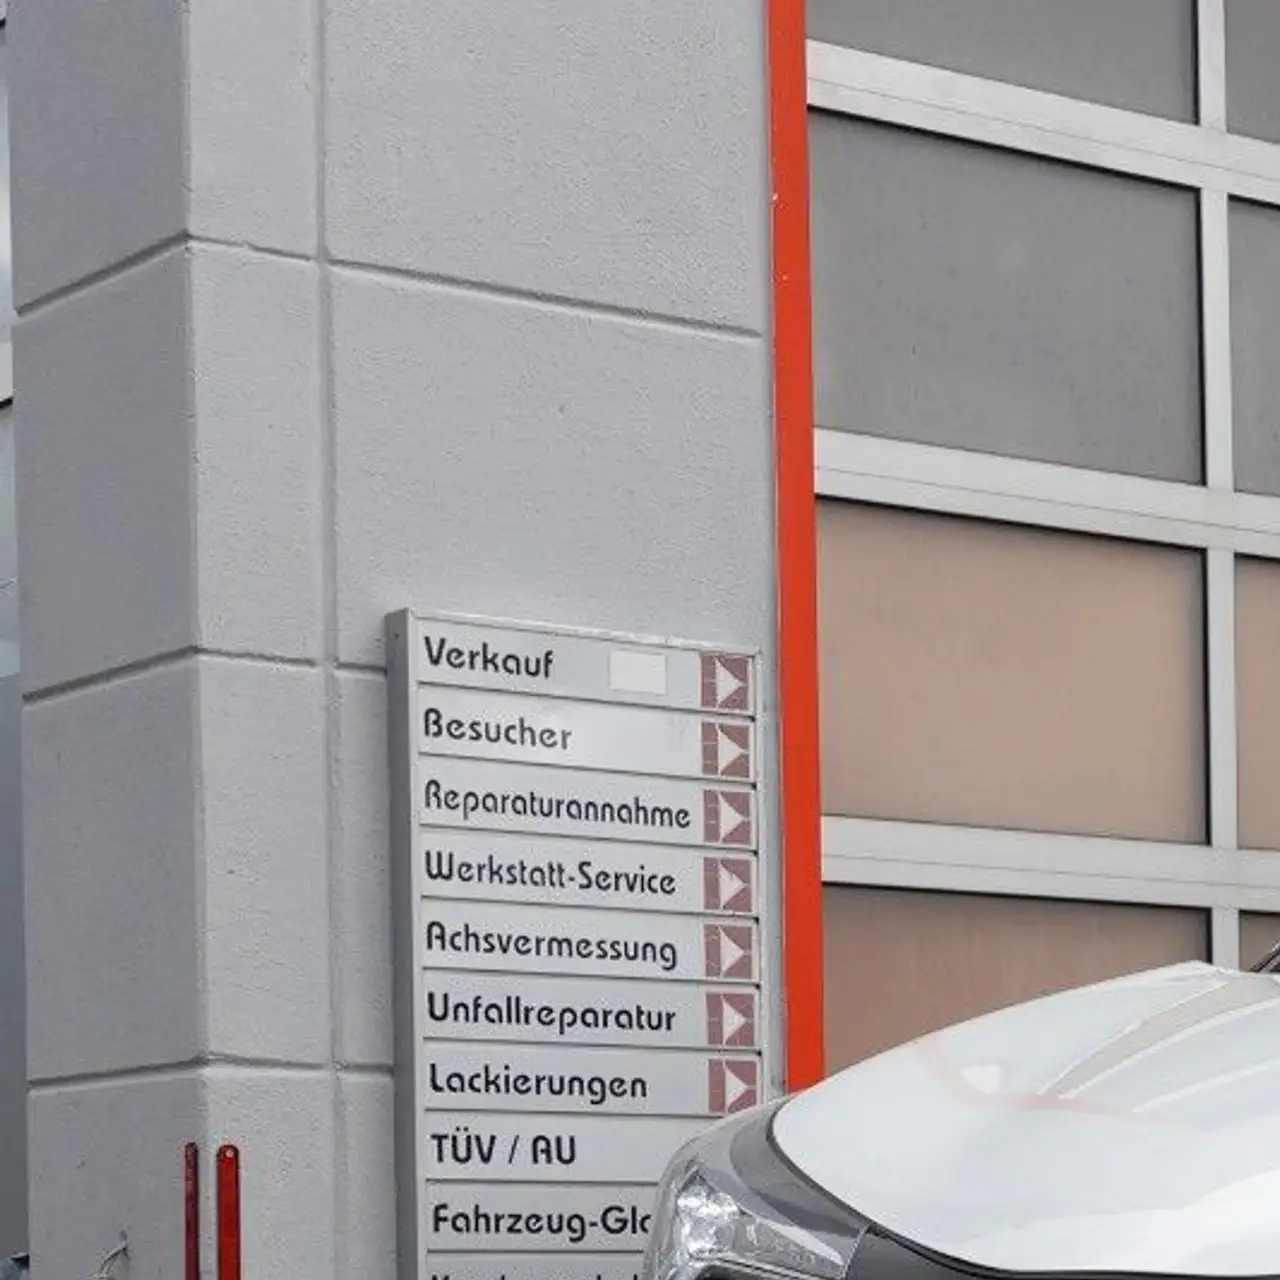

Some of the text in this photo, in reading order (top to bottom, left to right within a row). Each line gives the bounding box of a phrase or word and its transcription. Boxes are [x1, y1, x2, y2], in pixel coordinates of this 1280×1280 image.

[423, 635, 554, 679] Verkauf
[423, 707, 573, 751] Besucher
[424, 778, 692, 830] Reparaturannahme
[424, 849, 677, 895] Werkstatt-Service
[425, 920, 679, 972] Achsvermessung
[427, 990, 677, 1035] Unfallreparatur
[428, 1062, 648, 1106] Lackierungen
[430, 1126, 498, 1165] TÜV
[531, 1134, 577, 1165] AU
